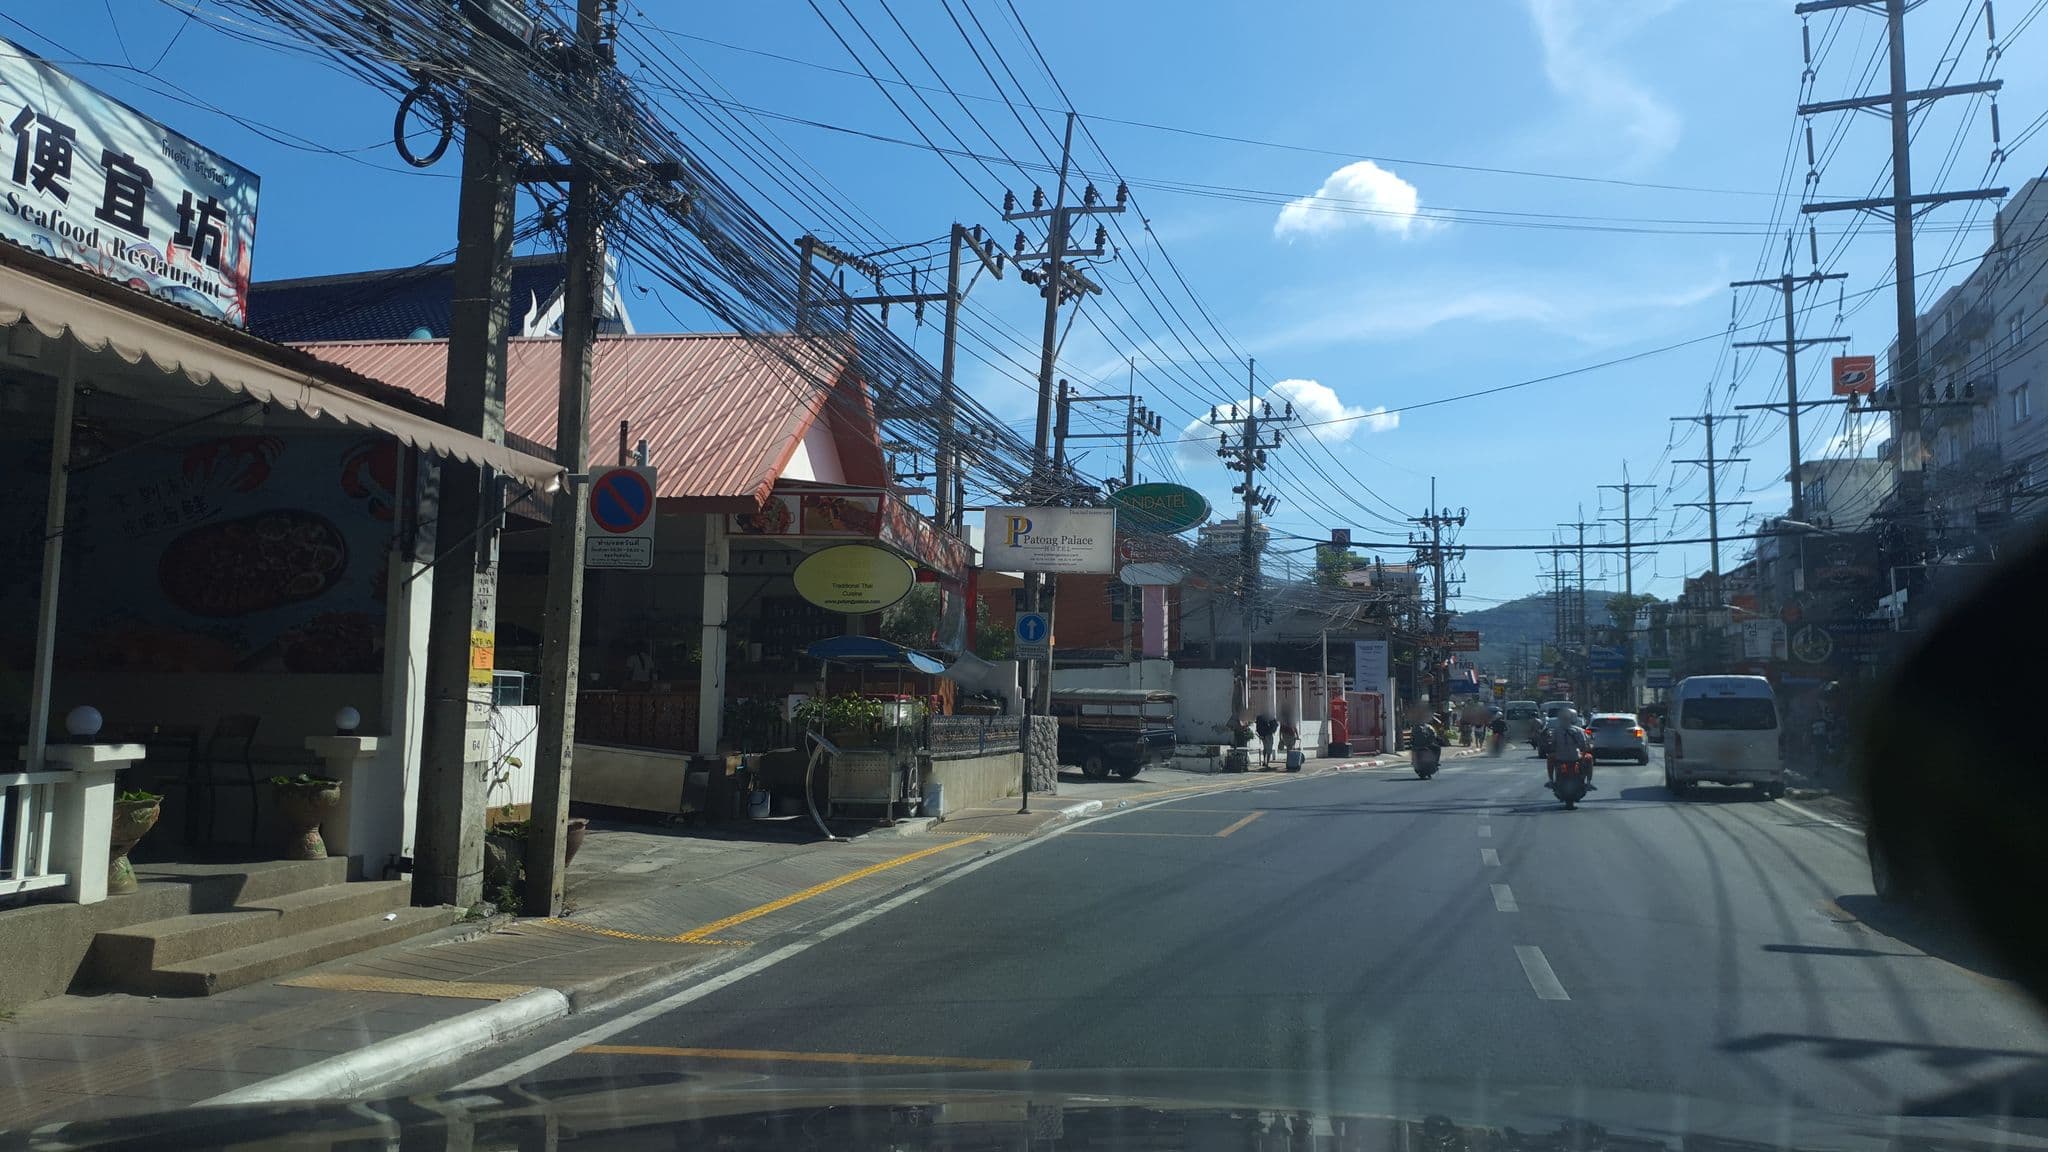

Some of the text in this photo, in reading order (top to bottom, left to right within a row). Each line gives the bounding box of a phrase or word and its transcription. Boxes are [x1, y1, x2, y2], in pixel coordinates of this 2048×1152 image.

[9, 104, 227, 270] 便宜坊
[5, 191, 220, 299] Seafood Restaurant
[1122, 493, 1185, 509] ANDATEL
[1023, 535, 1094, 547] Patong Palace
[472, 740, 481, 751] 64
